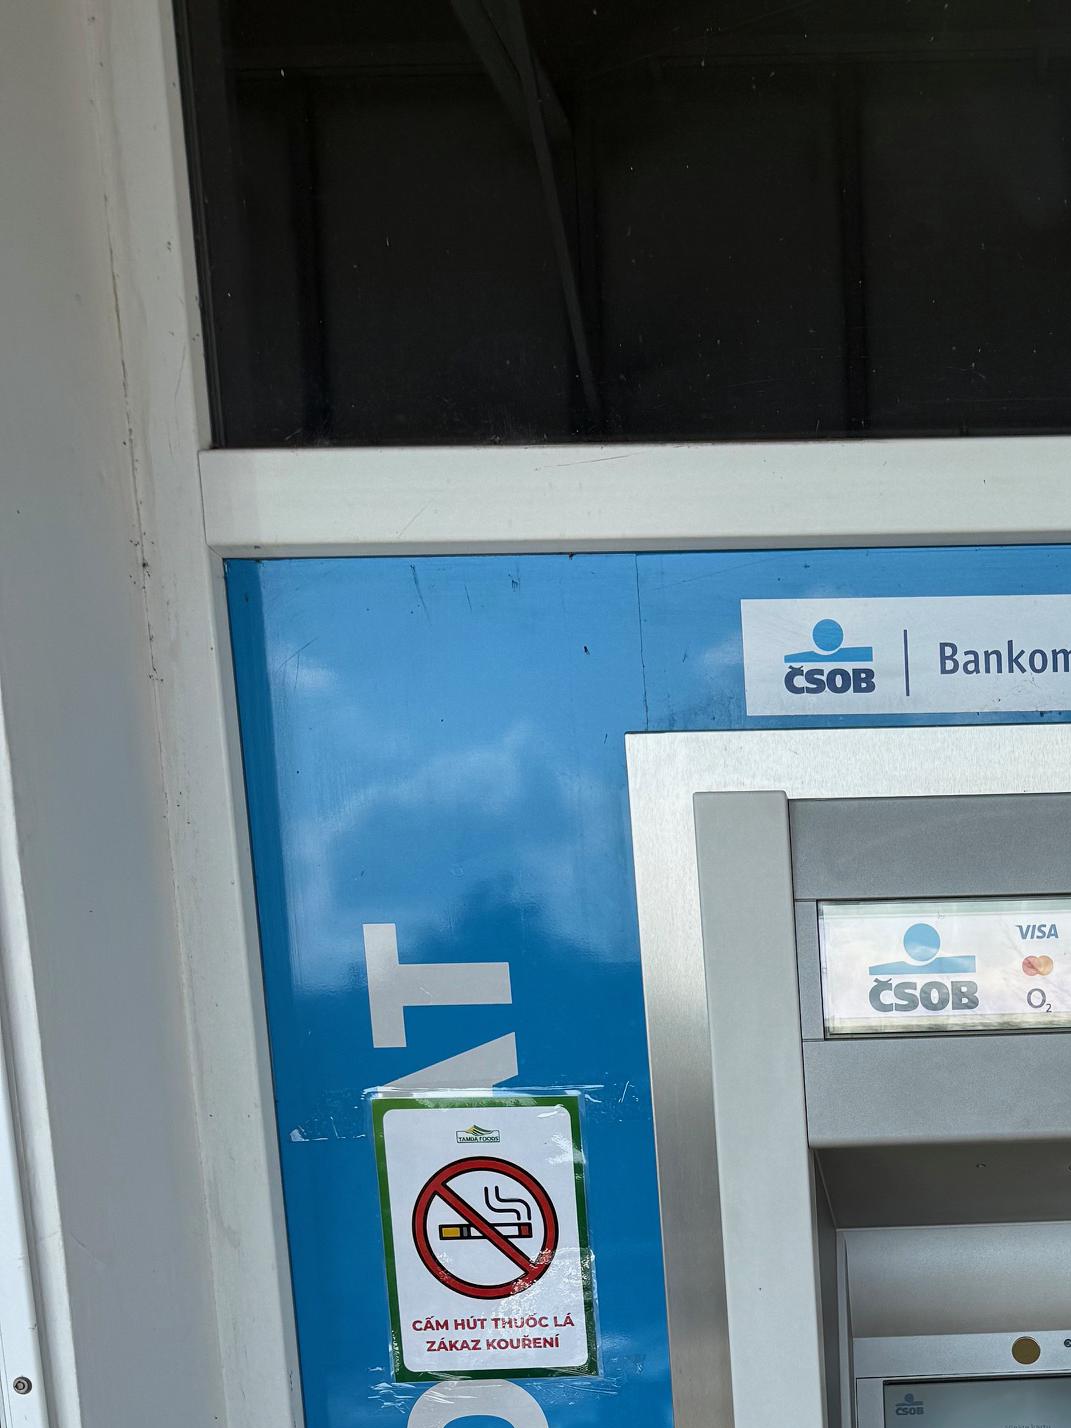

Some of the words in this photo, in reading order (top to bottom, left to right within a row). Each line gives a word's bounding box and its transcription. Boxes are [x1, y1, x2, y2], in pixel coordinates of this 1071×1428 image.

[784, 665, 876, 694] ČSOB
[1016, 924, 1059, 940] VISA
[869, 978, 979, 1012] ČSOB
[412, 1315, 449, 1331] CẤM
[454, 1316, 487, 1330] HÚT
[491, 1313, 549, 1329] THUỐC
[553, 1313, 575, 1327] LÁ
[426, 1338, 481, 1352] ZÁKAZ
[486, 1334, 560, 1350] KOUŘENÍ
